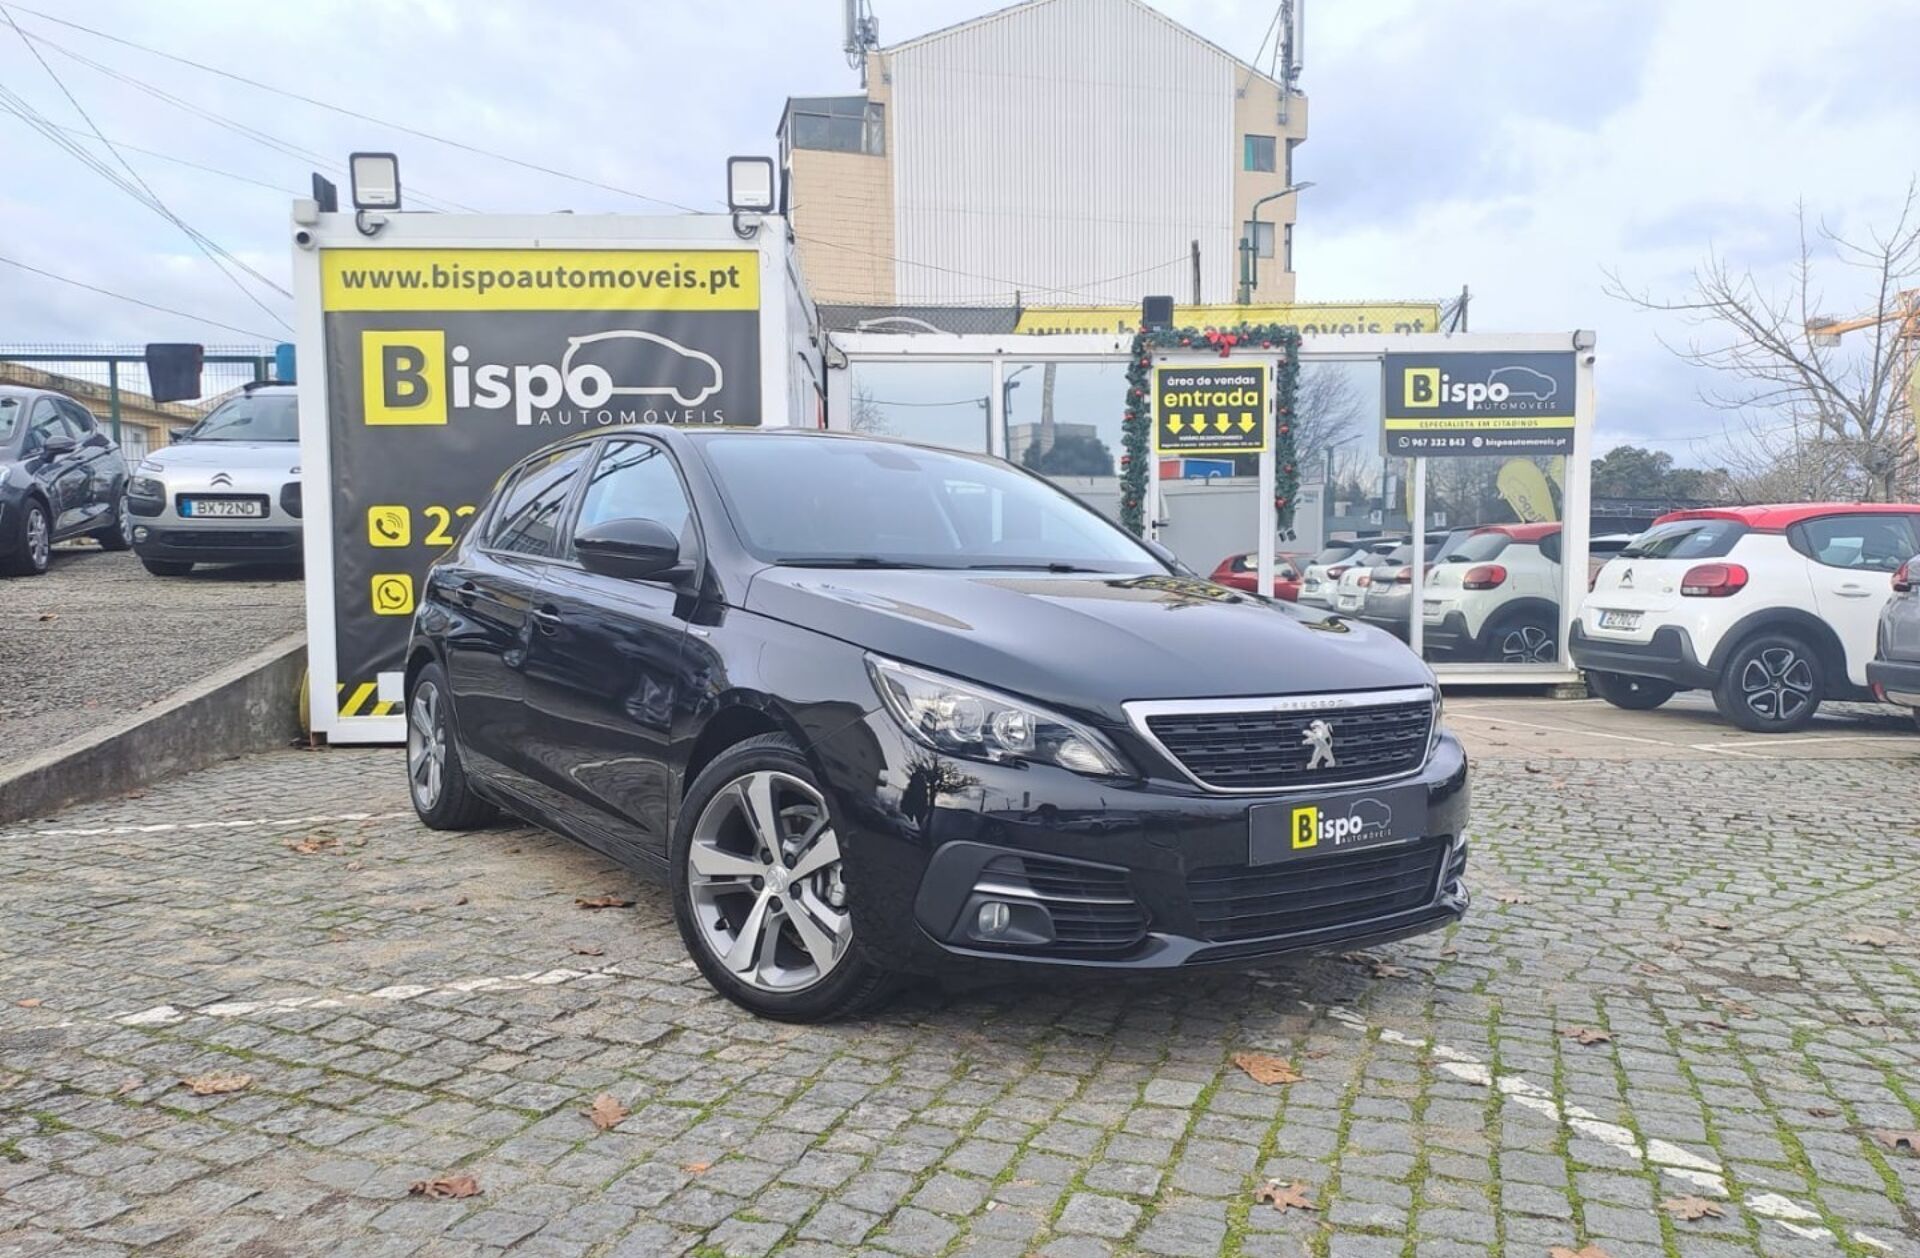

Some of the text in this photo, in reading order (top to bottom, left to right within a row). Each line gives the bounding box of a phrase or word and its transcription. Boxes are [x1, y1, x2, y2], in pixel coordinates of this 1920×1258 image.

[341, 264, 740, 295] www.bispoautomoveis.pt
[381, 344, 613, 426] Bispo
[1167, 375, 1256, 386] área de vendas
[1412, 373, 1510, 411] Bispo
[1163, 387, 1259, 408] entrada
[1477, 420, 1490, 428] EM
[1411, 438, 1427, 447] 967
[1298, 810, 1363, 845] Bispo
